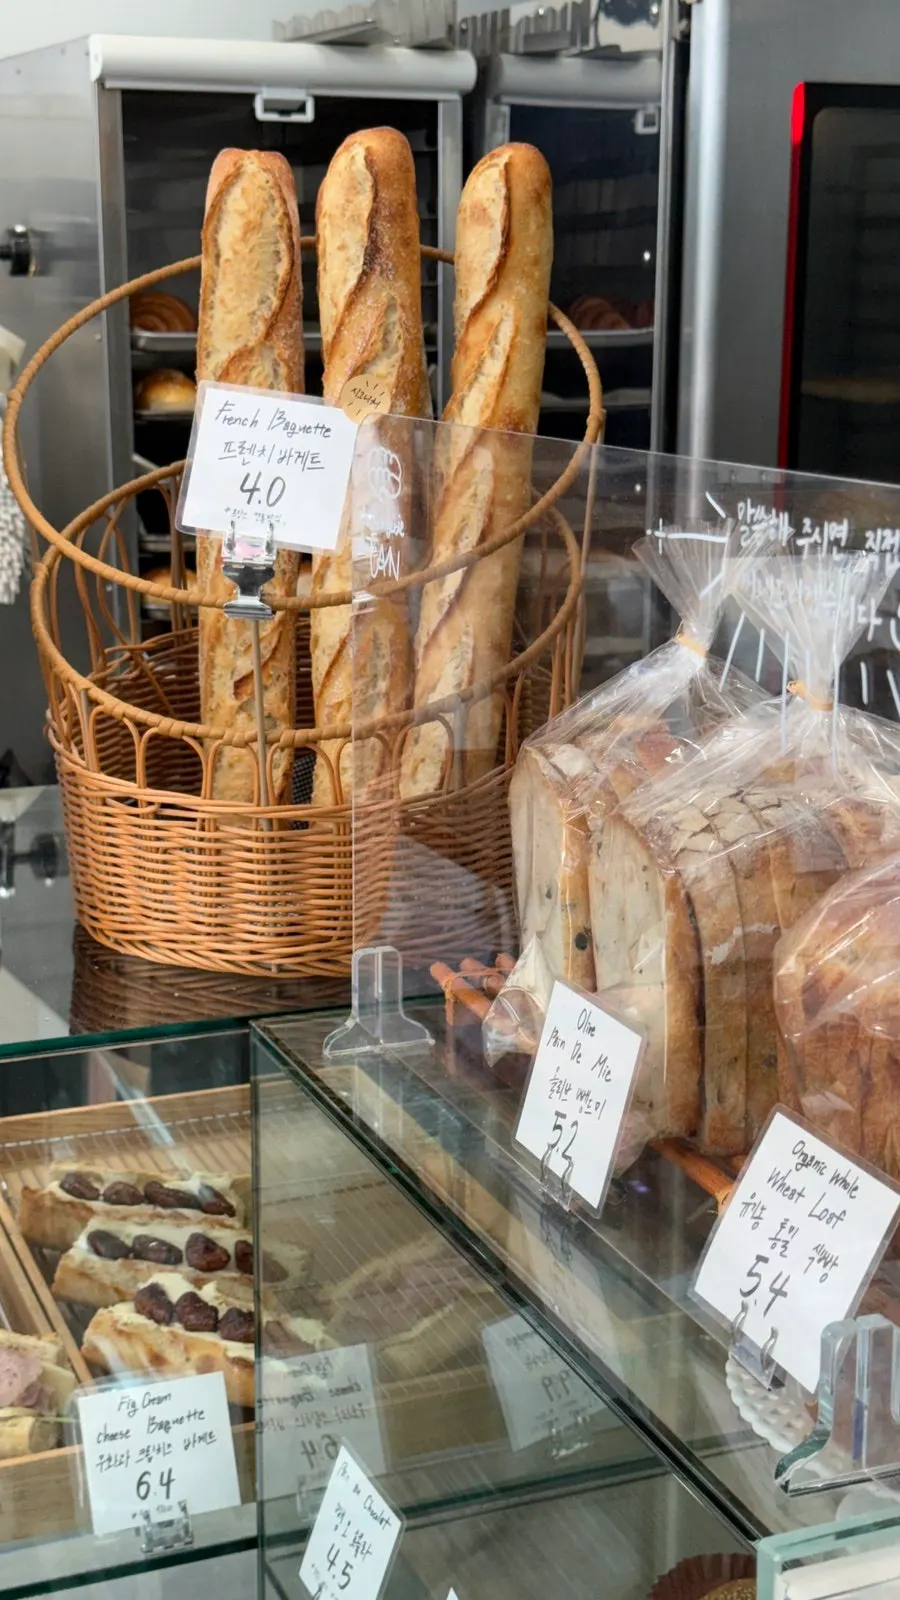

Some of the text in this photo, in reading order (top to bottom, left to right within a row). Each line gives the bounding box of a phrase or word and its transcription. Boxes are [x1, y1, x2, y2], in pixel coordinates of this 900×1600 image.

[215, 400, 333, 439] French Baguette
[218, 441, 326, 472] 프렌치 바게트
[239, 471, 287, 508] 4.0
[577, 1008, 597, 1038] Olive
[546, 1025, 612, 1083] Pain De Mie
[791, 1139, 828, 1177] Organic
[738, 1192, 768, 1230] 유기농
[766, 1167, 847, 1230] Wheat Loaf
[738, 1254, 791, 1318] 5.4
[117, 1394, 137, 1418] Fig
[146, 1407, 207, 1435] Baguette
[135, 1467, 176, 1501] 6.4
[325, 1542, 354, 1591] 4.5
